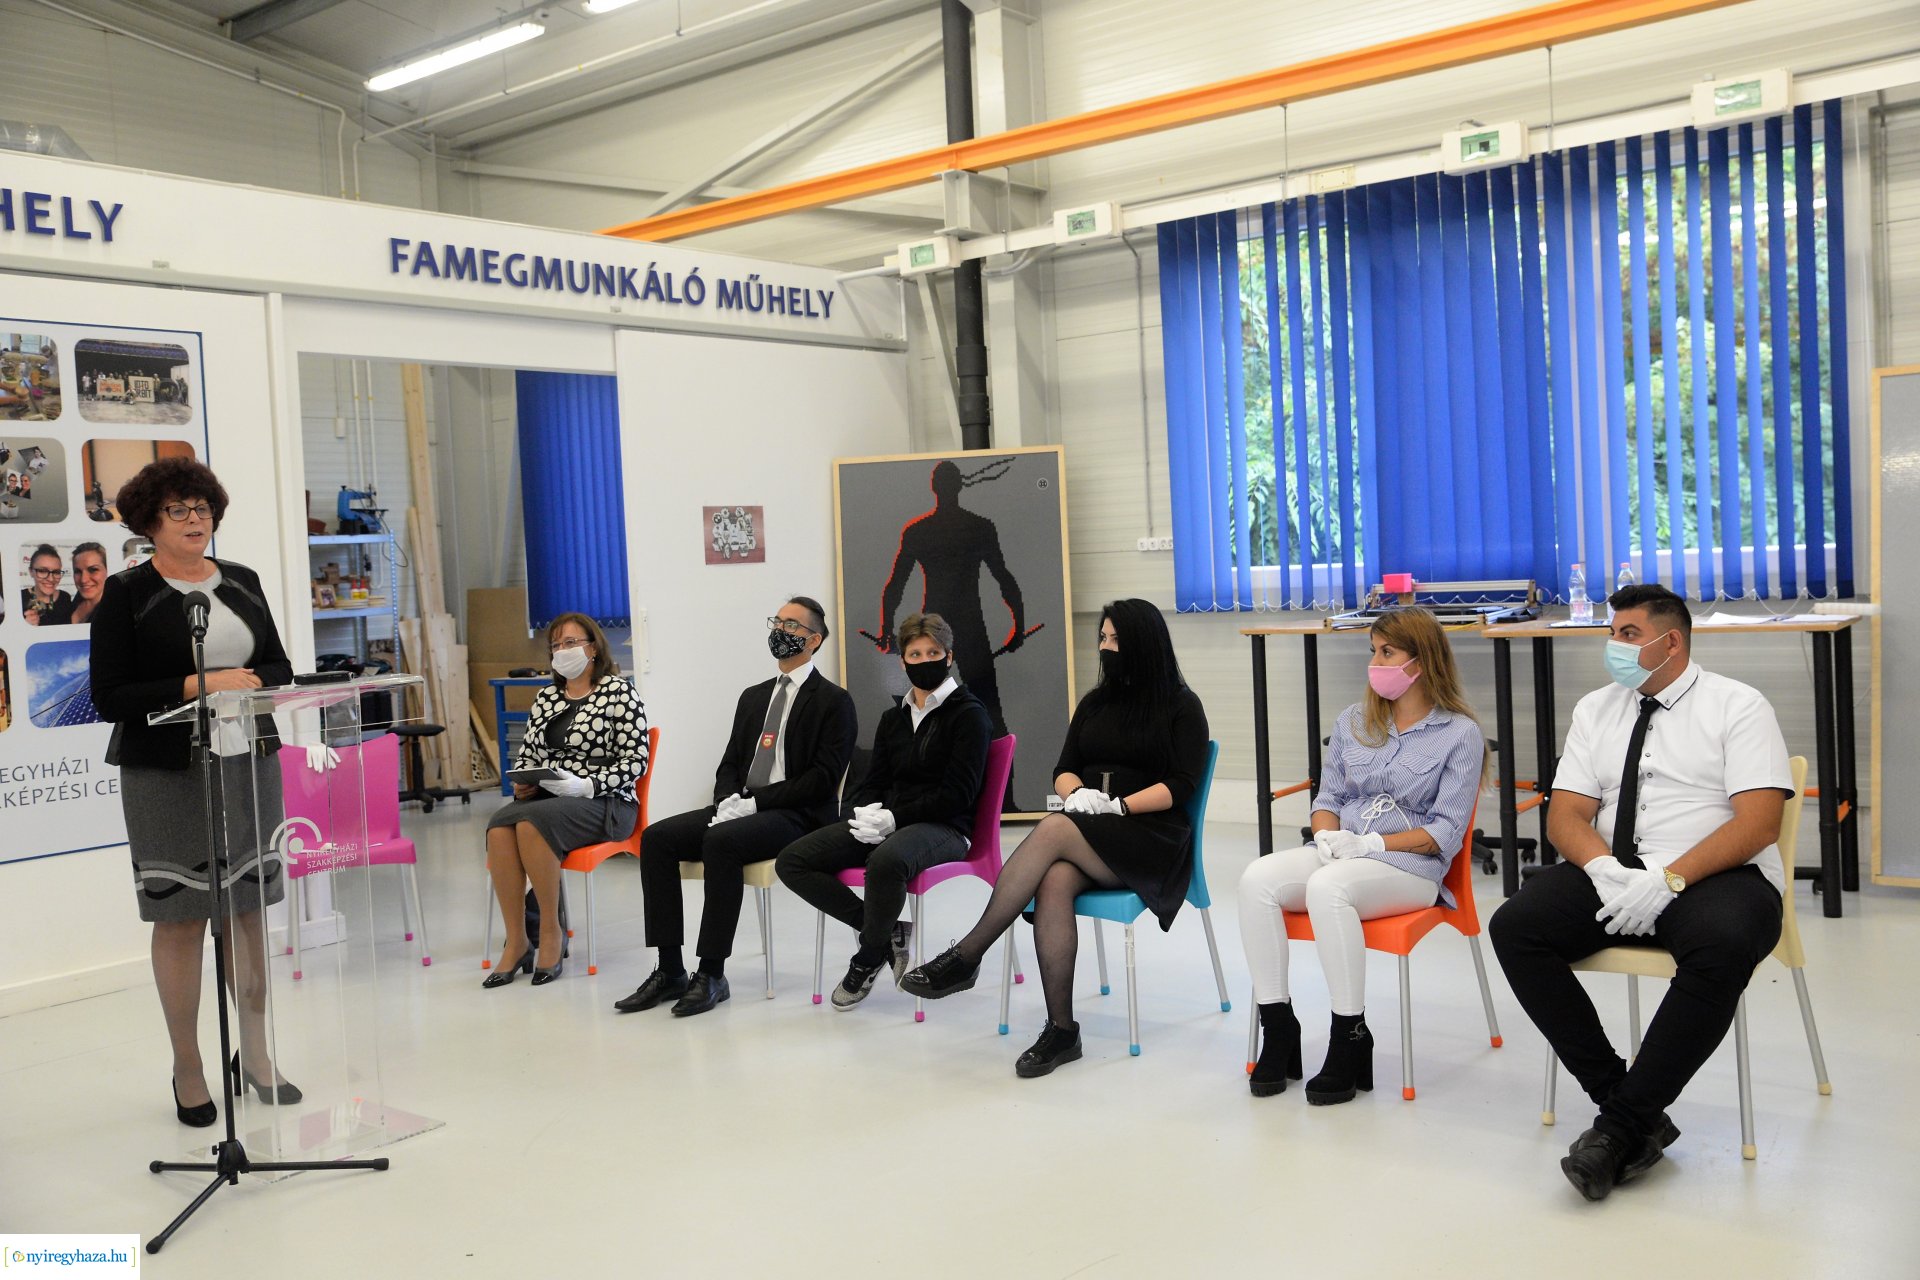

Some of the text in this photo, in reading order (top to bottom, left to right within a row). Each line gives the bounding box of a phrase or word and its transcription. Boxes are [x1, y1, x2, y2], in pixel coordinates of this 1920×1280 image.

[389, 237, 834, 318] FAMEGMUNKÁLÓ MŰHELY
[0, 781, 88, 809] KÉPZÉSI
[306, 853, 357, 869] SZAKKÉPZÉSI
